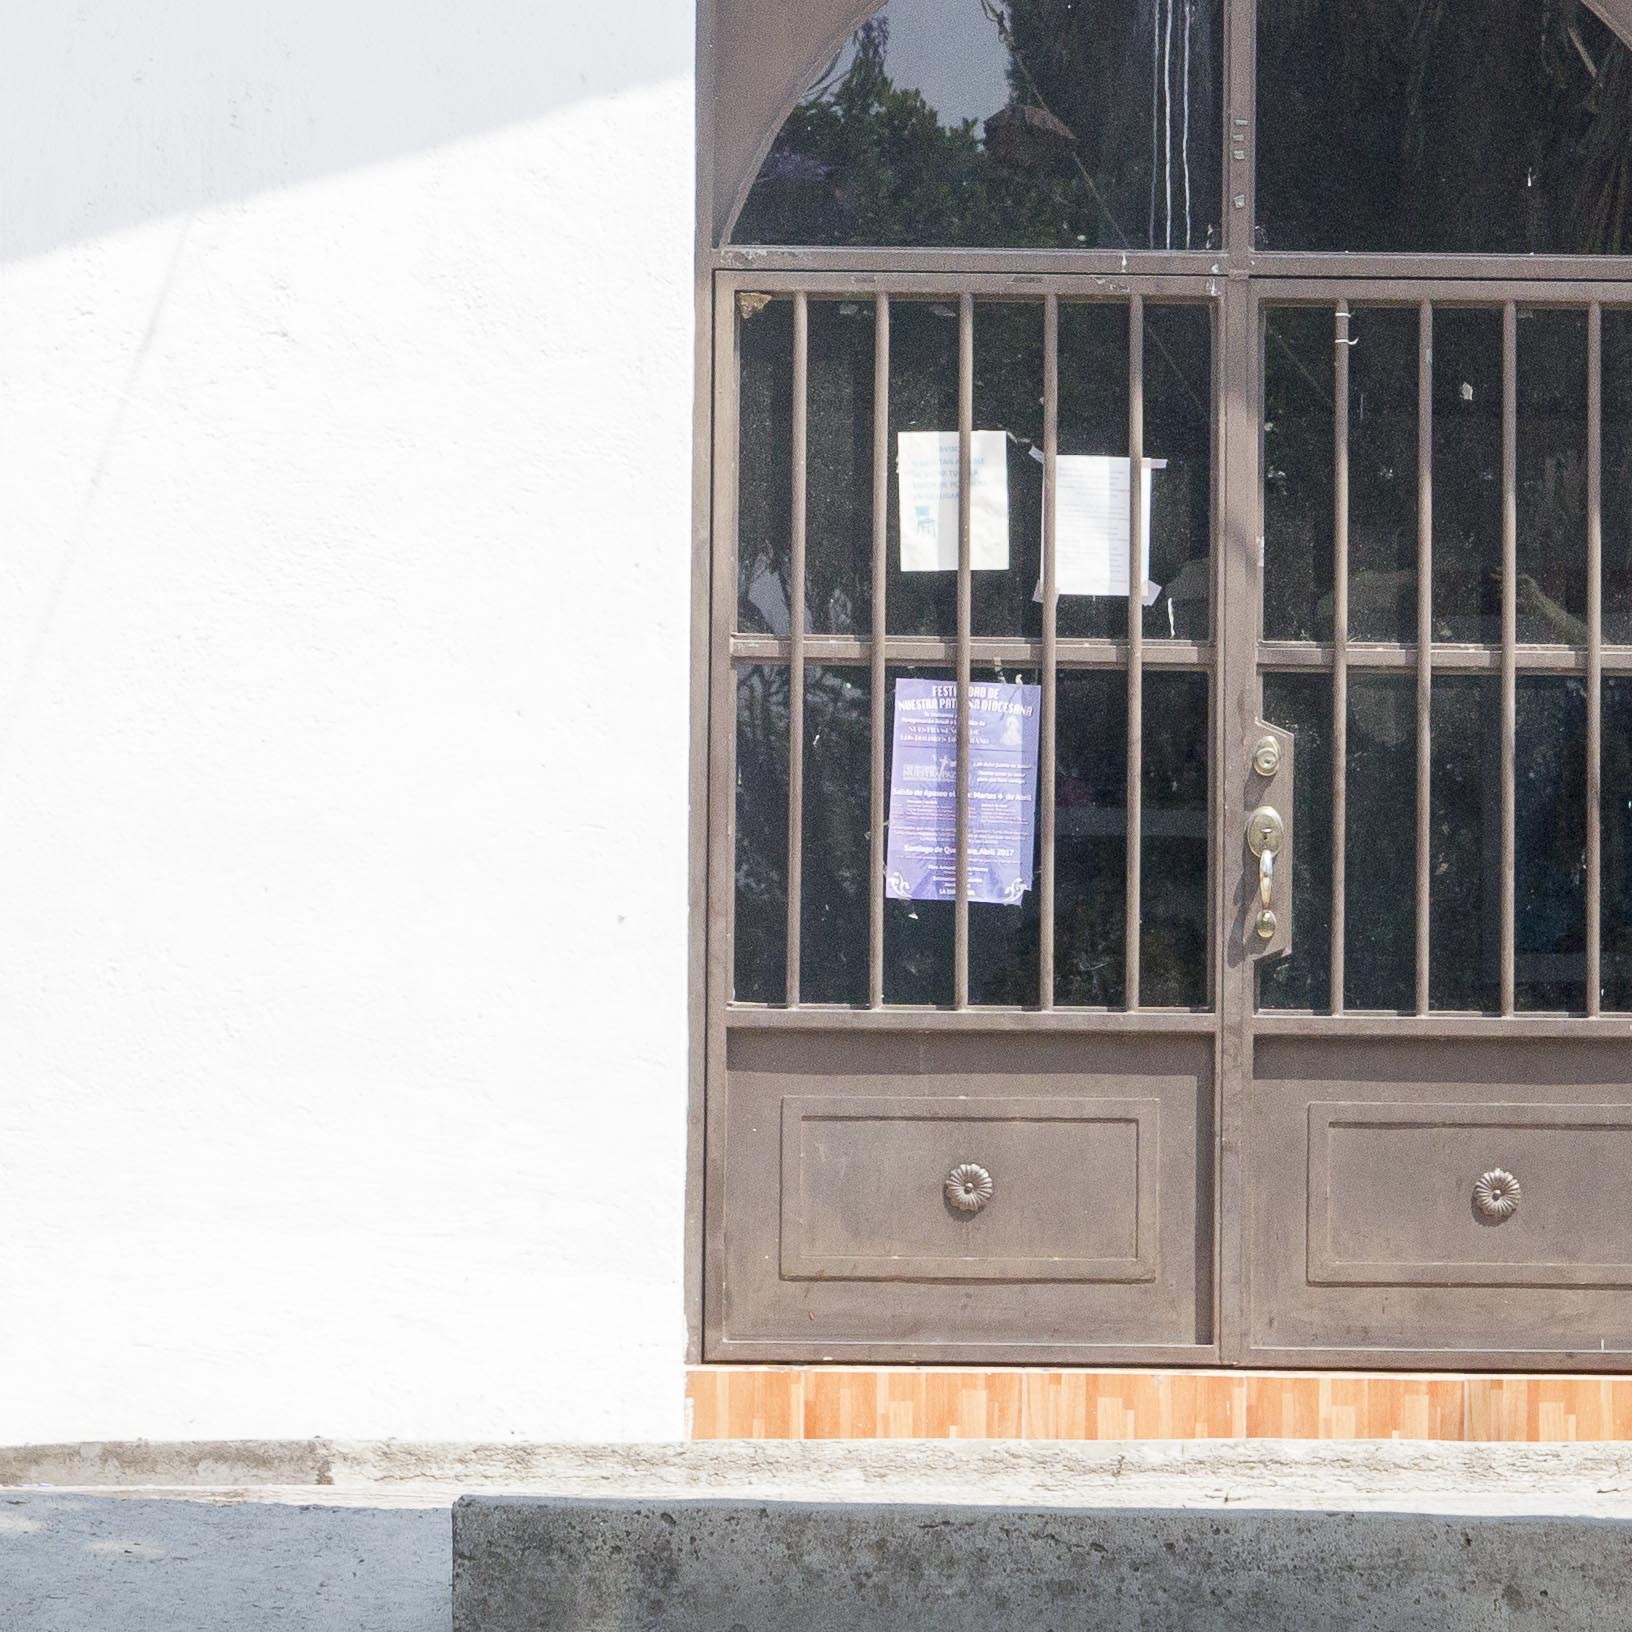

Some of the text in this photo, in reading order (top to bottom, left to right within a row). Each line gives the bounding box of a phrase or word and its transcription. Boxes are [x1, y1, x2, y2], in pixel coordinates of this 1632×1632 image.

[932, 685, 1000, 699] FESTIDAD DE
[897, 698, 1033, 717] NUESTRA PATNA DIOCESANA
[904, 844, 933, 854] Santiago
[997, 848, 1015, 856] 2017
